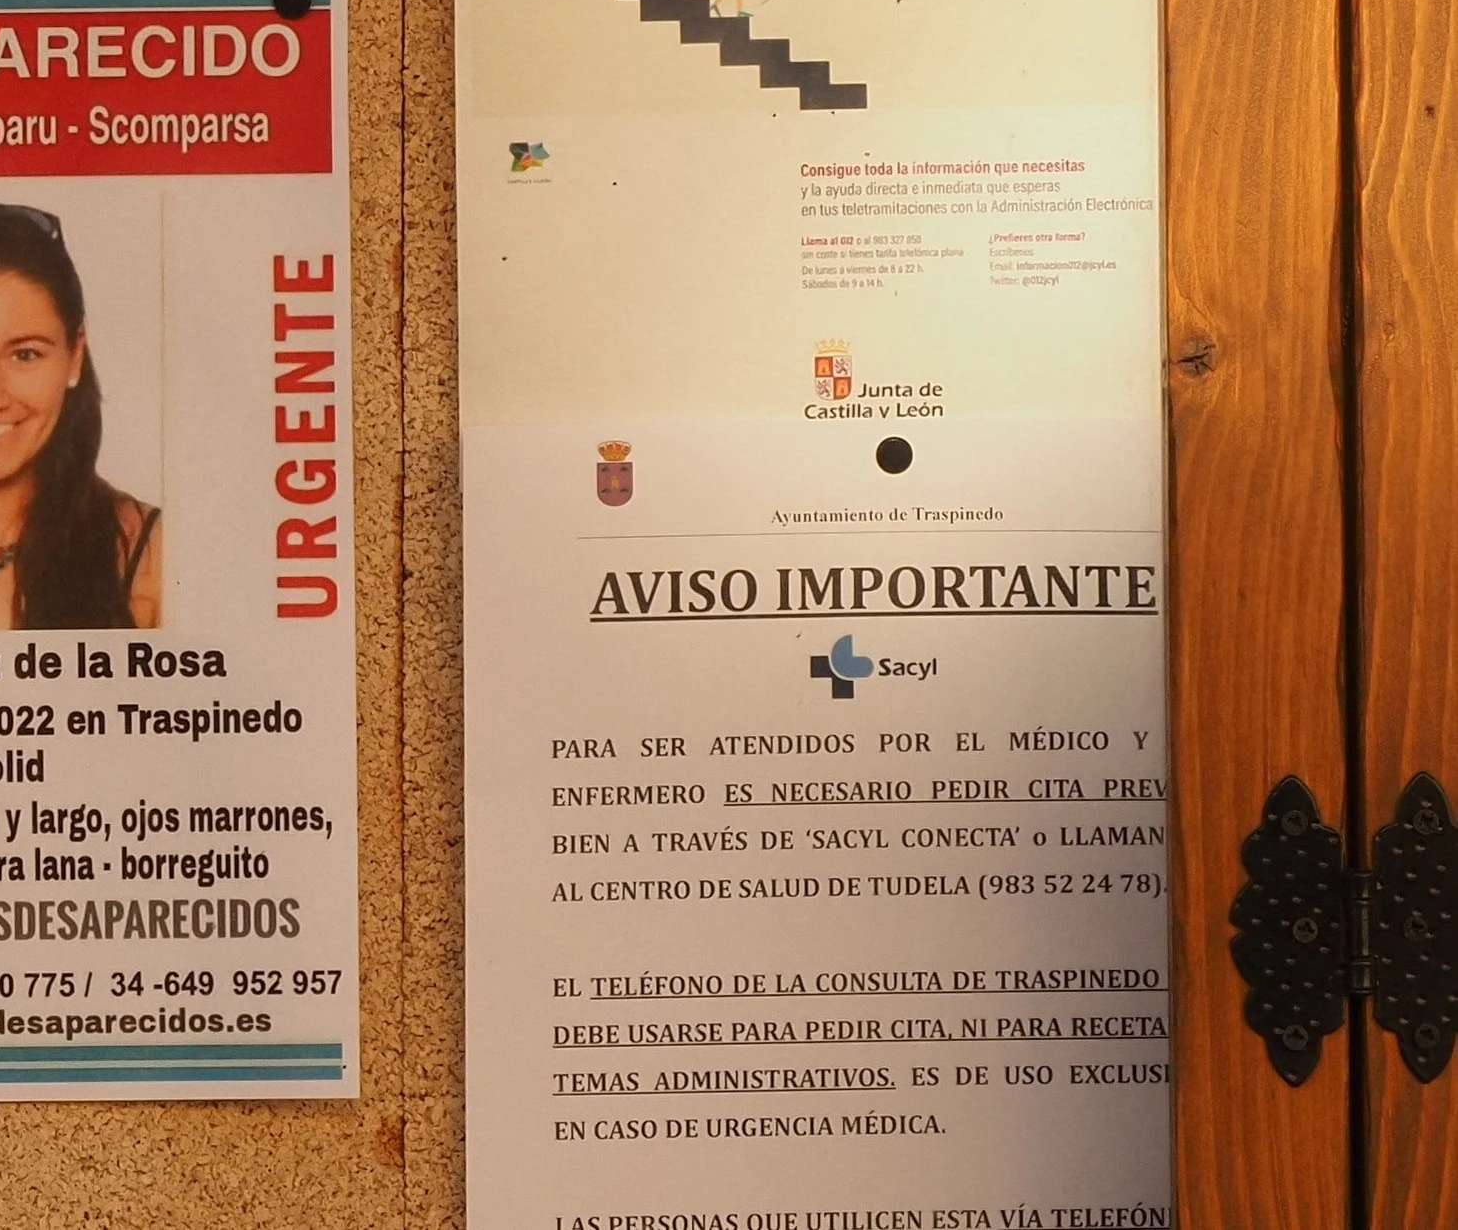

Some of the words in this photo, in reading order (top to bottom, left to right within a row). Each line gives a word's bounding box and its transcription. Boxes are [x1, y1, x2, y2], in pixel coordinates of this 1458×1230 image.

[90, 106, 268, 153] Scomparsa
[801, 163, 861, 179] Consigue
[865, 162, 892, 175] toda
[897, 162, 908, 174] la
[913, 162, 990, 174] información
[995, 163, 1018, 176] que
[1023, 159, 1085, 172] necesitas
[858, 384, 912, 397] Junta
[920, 383, 942, 396] de
[805, 402, 872, 419] Castilla
[879, 406, 889, 418] y
[897, 402, 943, 417] León
[273, 254, 338, 618] URGENTE
[590, 570, 757, 614] AVISO
[777, 566, 1155, 610] IMPORTANTE
[15, 643, 61, 679] de
[78, 642, 113, 678] la
[128, 643, 226, 677] Rosa
[879, 658, 936, 680] Sacyl
[68, 711, 105, 734] en
[118, 700, 302, 742] Traspinedo
[555, 1121, 585, 1140] EN
[595, 1120, 657, 1139] CASO
[667, 1120, 698, 1138] DE
[707, 1117, 833, 1137] URGENCIA
[842, 1110, 945, 1135] MÉDICA.
